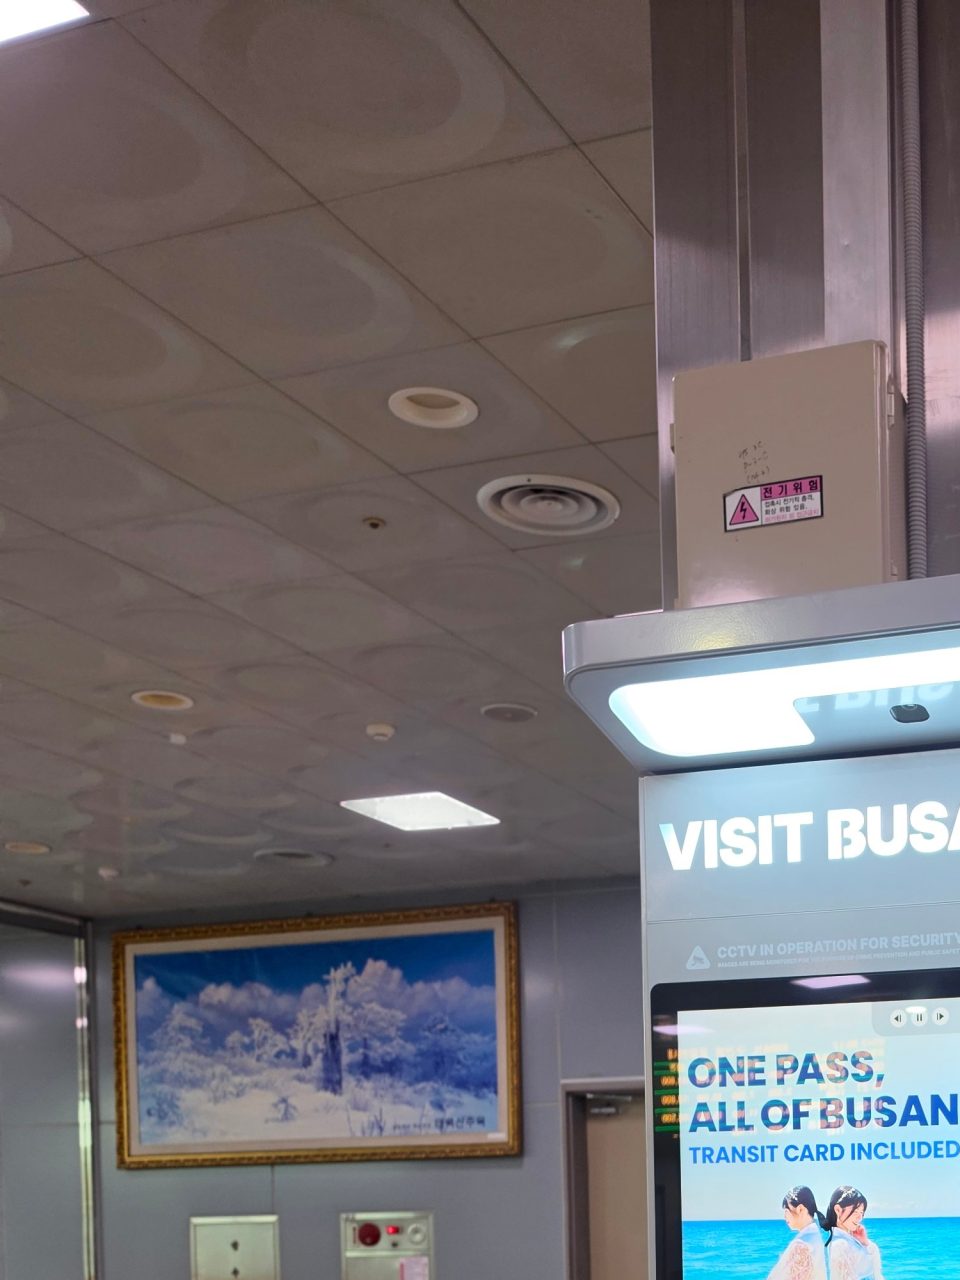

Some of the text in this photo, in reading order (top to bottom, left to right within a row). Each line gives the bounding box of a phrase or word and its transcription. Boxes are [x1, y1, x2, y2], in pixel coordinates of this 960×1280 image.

[659, 811, 813, 871] VISIT
[717, 944, 757, 959] CCTV
[760, 943, 774, 956] IN
[776, 938, 858, 955] OPERATION
[860, 935, 889, 950] FOR
[687, 1054, 766, 1089] ONE
[775, 1050, 886, 1088] PASS,
[688, 1093, 960, 1133] ALL OF BUSAN
[688, 1144, 779, 1164] TRANSIT
[783, 1142, 845, 1162] CARD
[850, 1139, 960, 1161] INCLUDED
